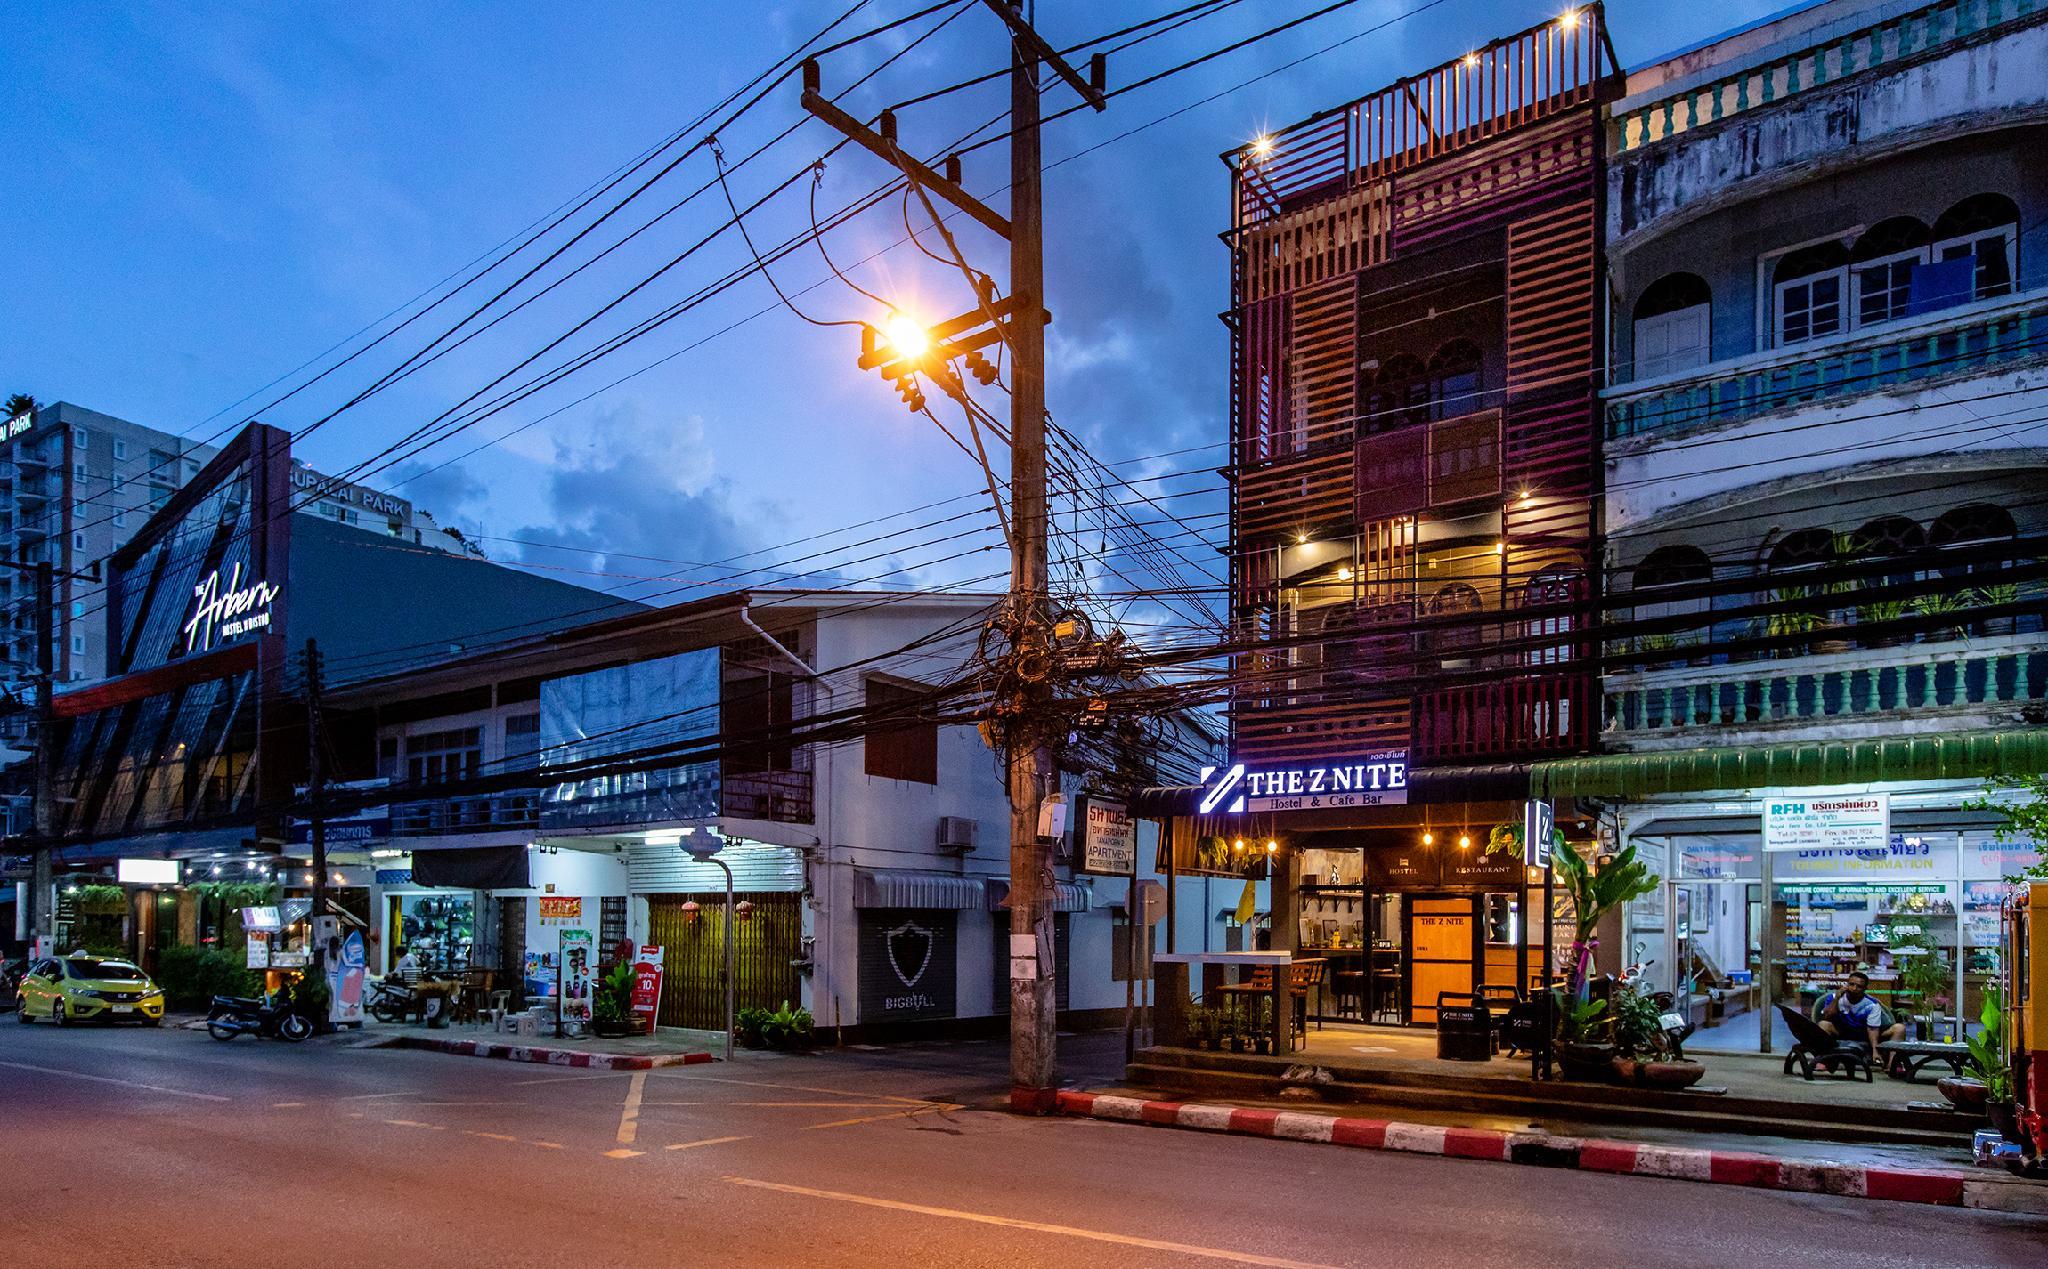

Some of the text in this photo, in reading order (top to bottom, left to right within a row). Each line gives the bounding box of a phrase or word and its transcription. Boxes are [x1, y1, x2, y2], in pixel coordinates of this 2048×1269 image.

[9, 411, 32, 438] PARK
[363, 492, 405, 517] PARK
[1247, 763, 1406, 795] THE Z NITE
[1270, 794, 1383, 809] Hostel & Cafe Bar
[1771, 803, 1805, 815] RFH
[1088, 845, 1132, 861] APARTMENT
[1389, 867, 1418, 875] HOSTEL
[1456, 866, 1511, 875] RESTAURANT
[1843, 858, 1933, 870] INFORMATION
[1446, 917, 1464, 925] NITE
[885, 992, 936, 1011] BIGBULL
